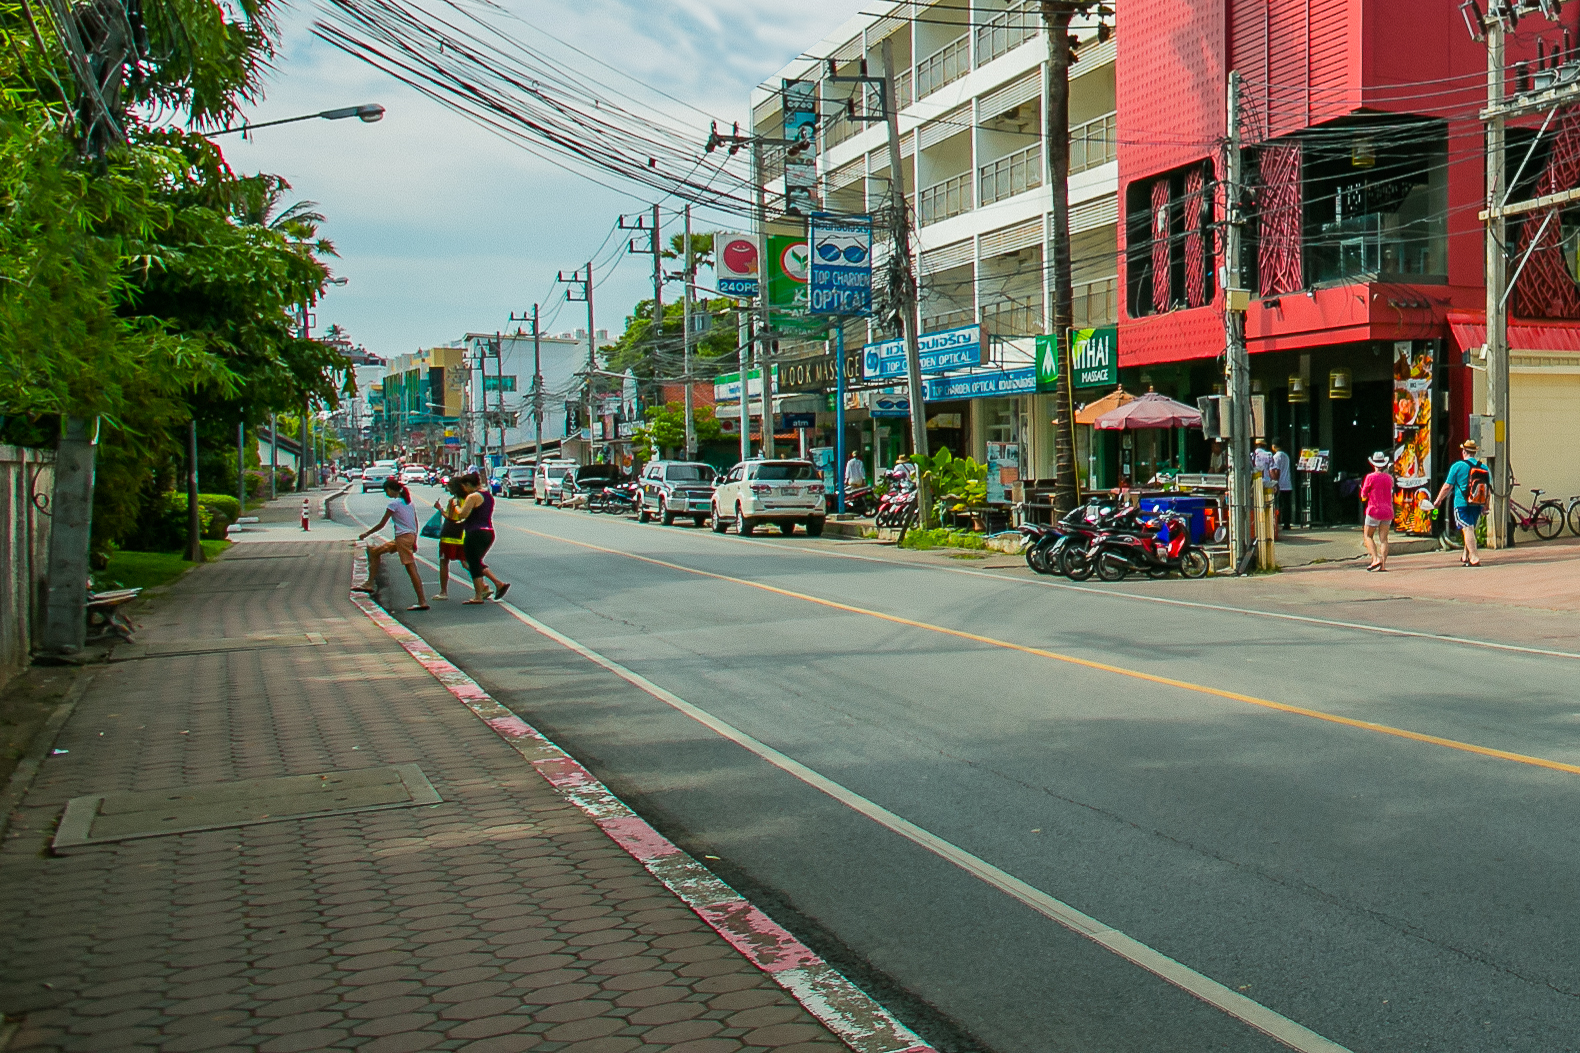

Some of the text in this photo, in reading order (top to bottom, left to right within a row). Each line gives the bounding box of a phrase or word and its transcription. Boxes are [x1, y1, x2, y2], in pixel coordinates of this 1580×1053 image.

[813, 269, 830, 285] TOP
[813, 288, 867, 310] OPTICAL
[816, 356, 860, 381] MASGE
[887, 362, 900, 372] TOP
[939, 350, 972, 365] OPTICAL
[1081, 369, 1109, 383] MASSAGE
[931, 386, 944, 397] TOP
[972, 380, 996, 393] OPTICAL
